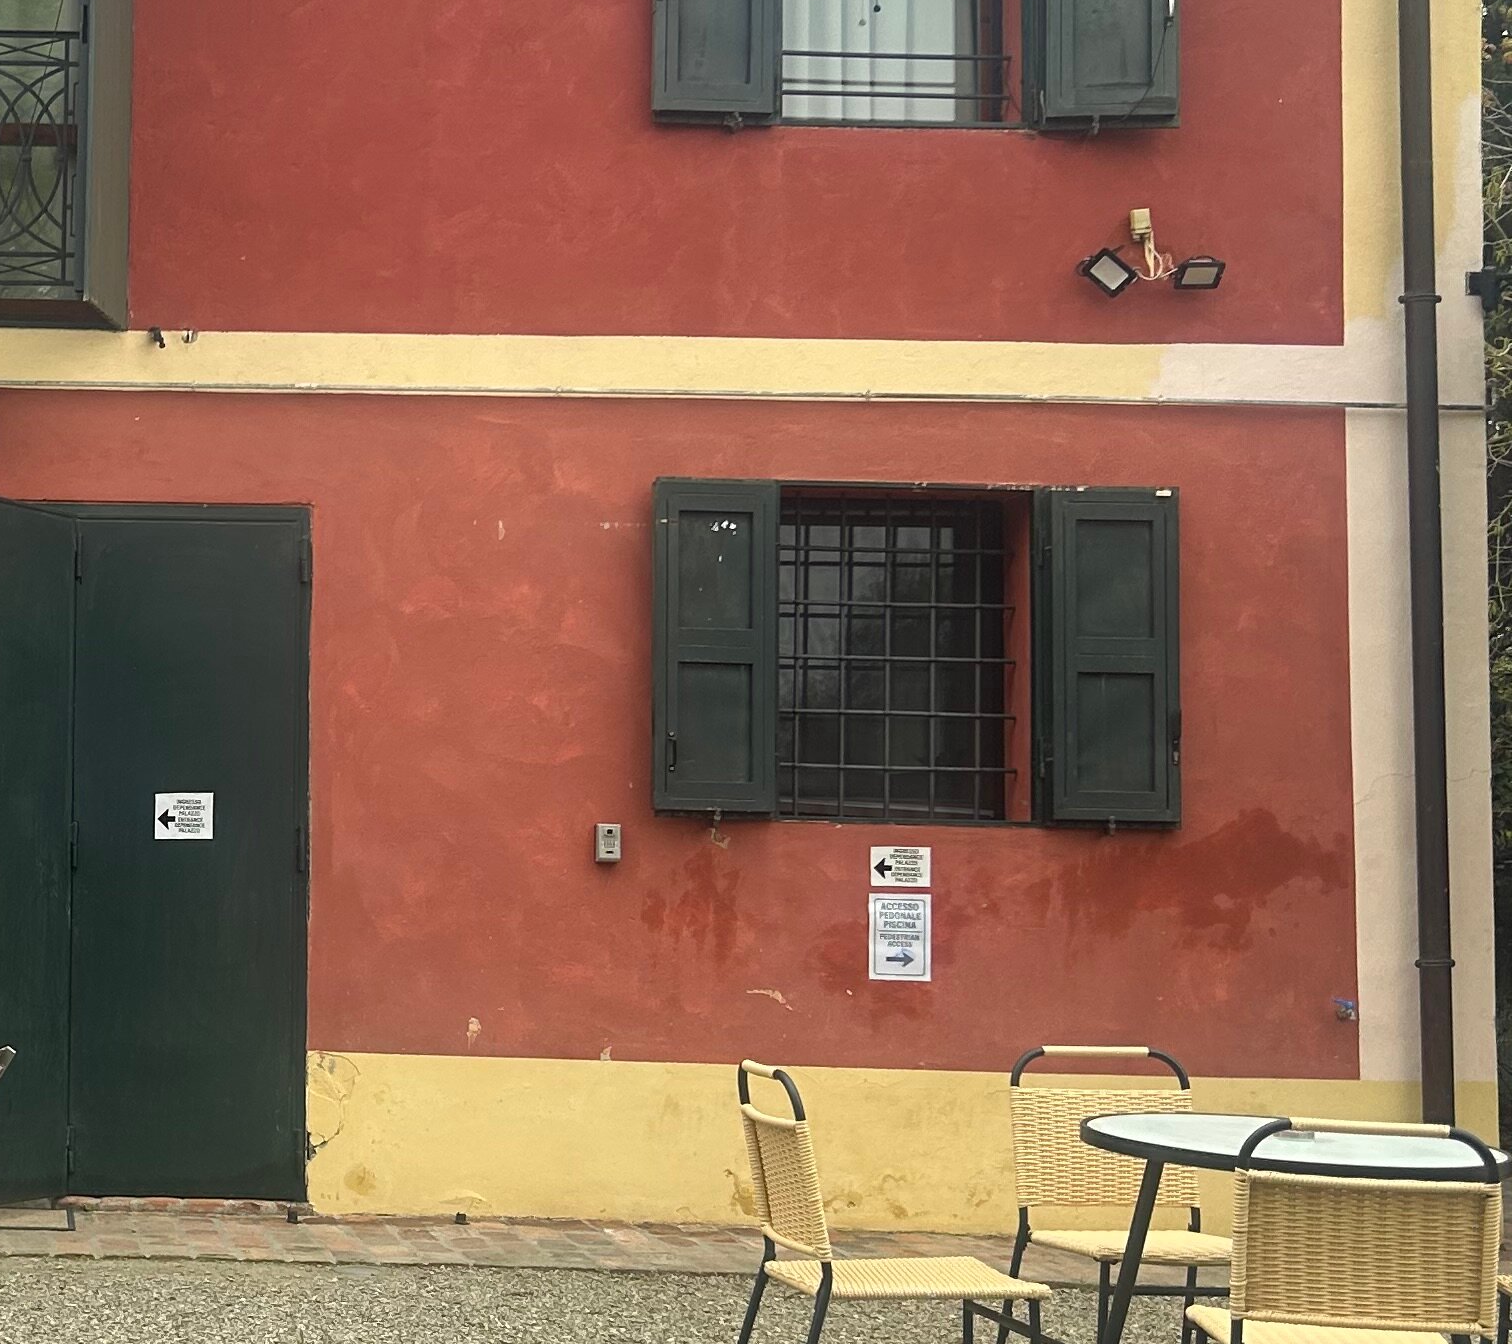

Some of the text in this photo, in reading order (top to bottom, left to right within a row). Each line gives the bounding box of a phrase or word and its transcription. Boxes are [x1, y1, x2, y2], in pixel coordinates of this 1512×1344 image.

[880, 903, 919, 911] ACCESSO
[879, 912, 922, 920] PEDONALE
[883, 921, 917, 929] PISCINA
